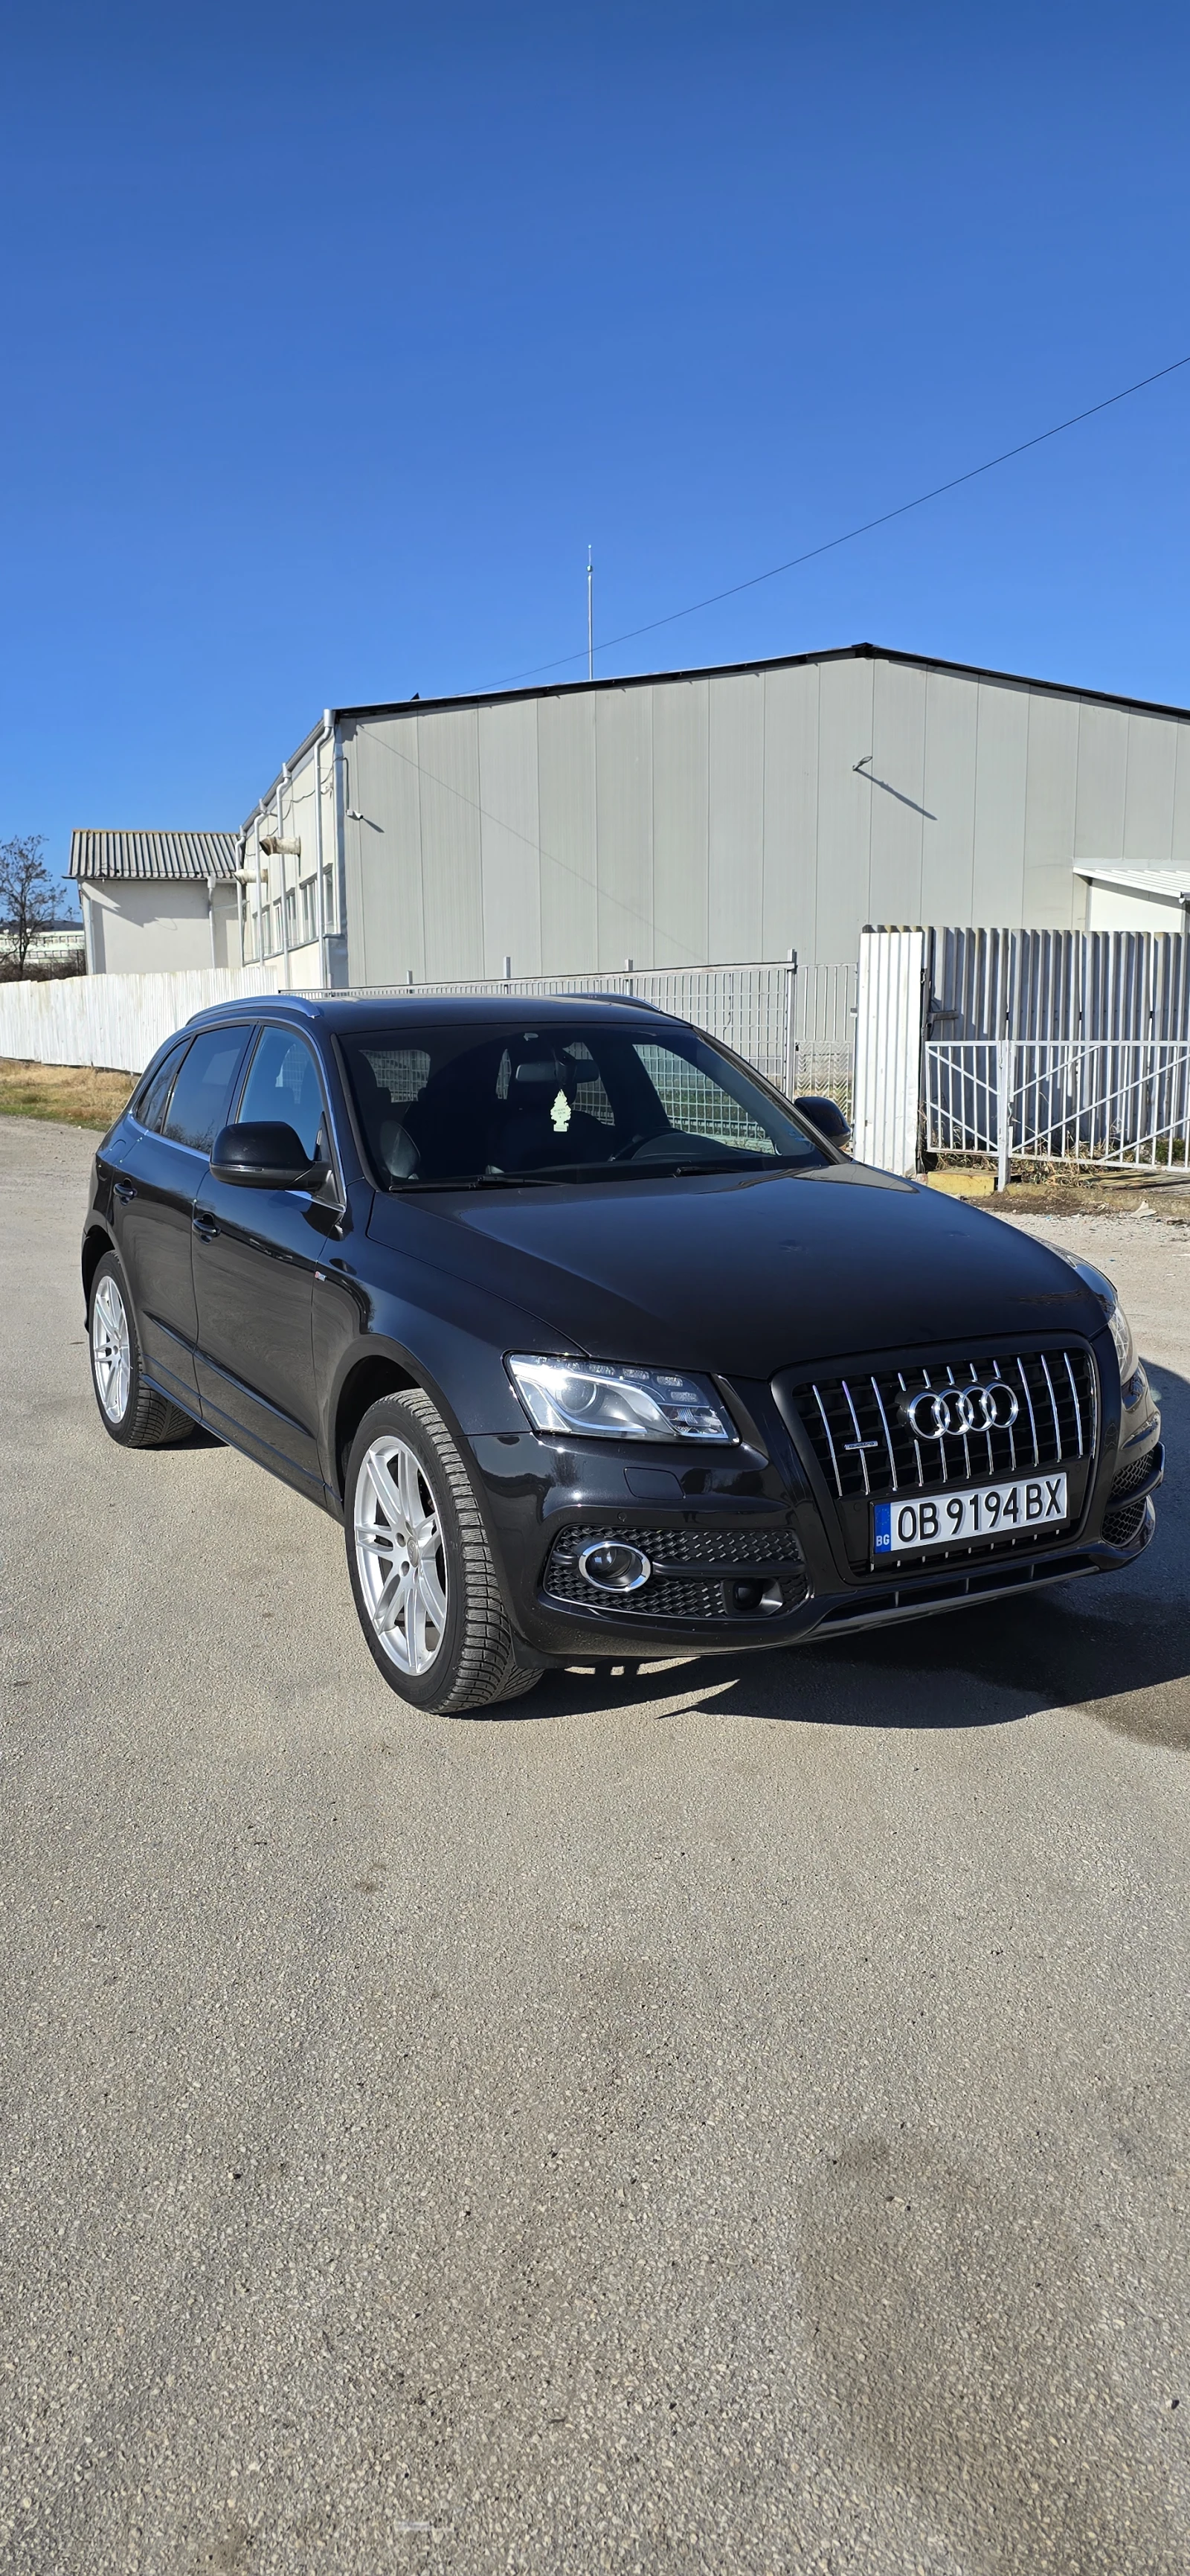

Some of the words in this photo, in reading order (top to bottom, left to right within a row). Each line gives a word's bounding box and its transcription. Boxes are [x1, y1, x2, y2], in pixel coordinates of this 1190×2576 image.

[898, 1502, 939, 1542] OB
[946, 1487, 1019, 1535] 9194
[1026, 1479, 1061, 1520] BX
[876, 1534, 890, 1547] BG
